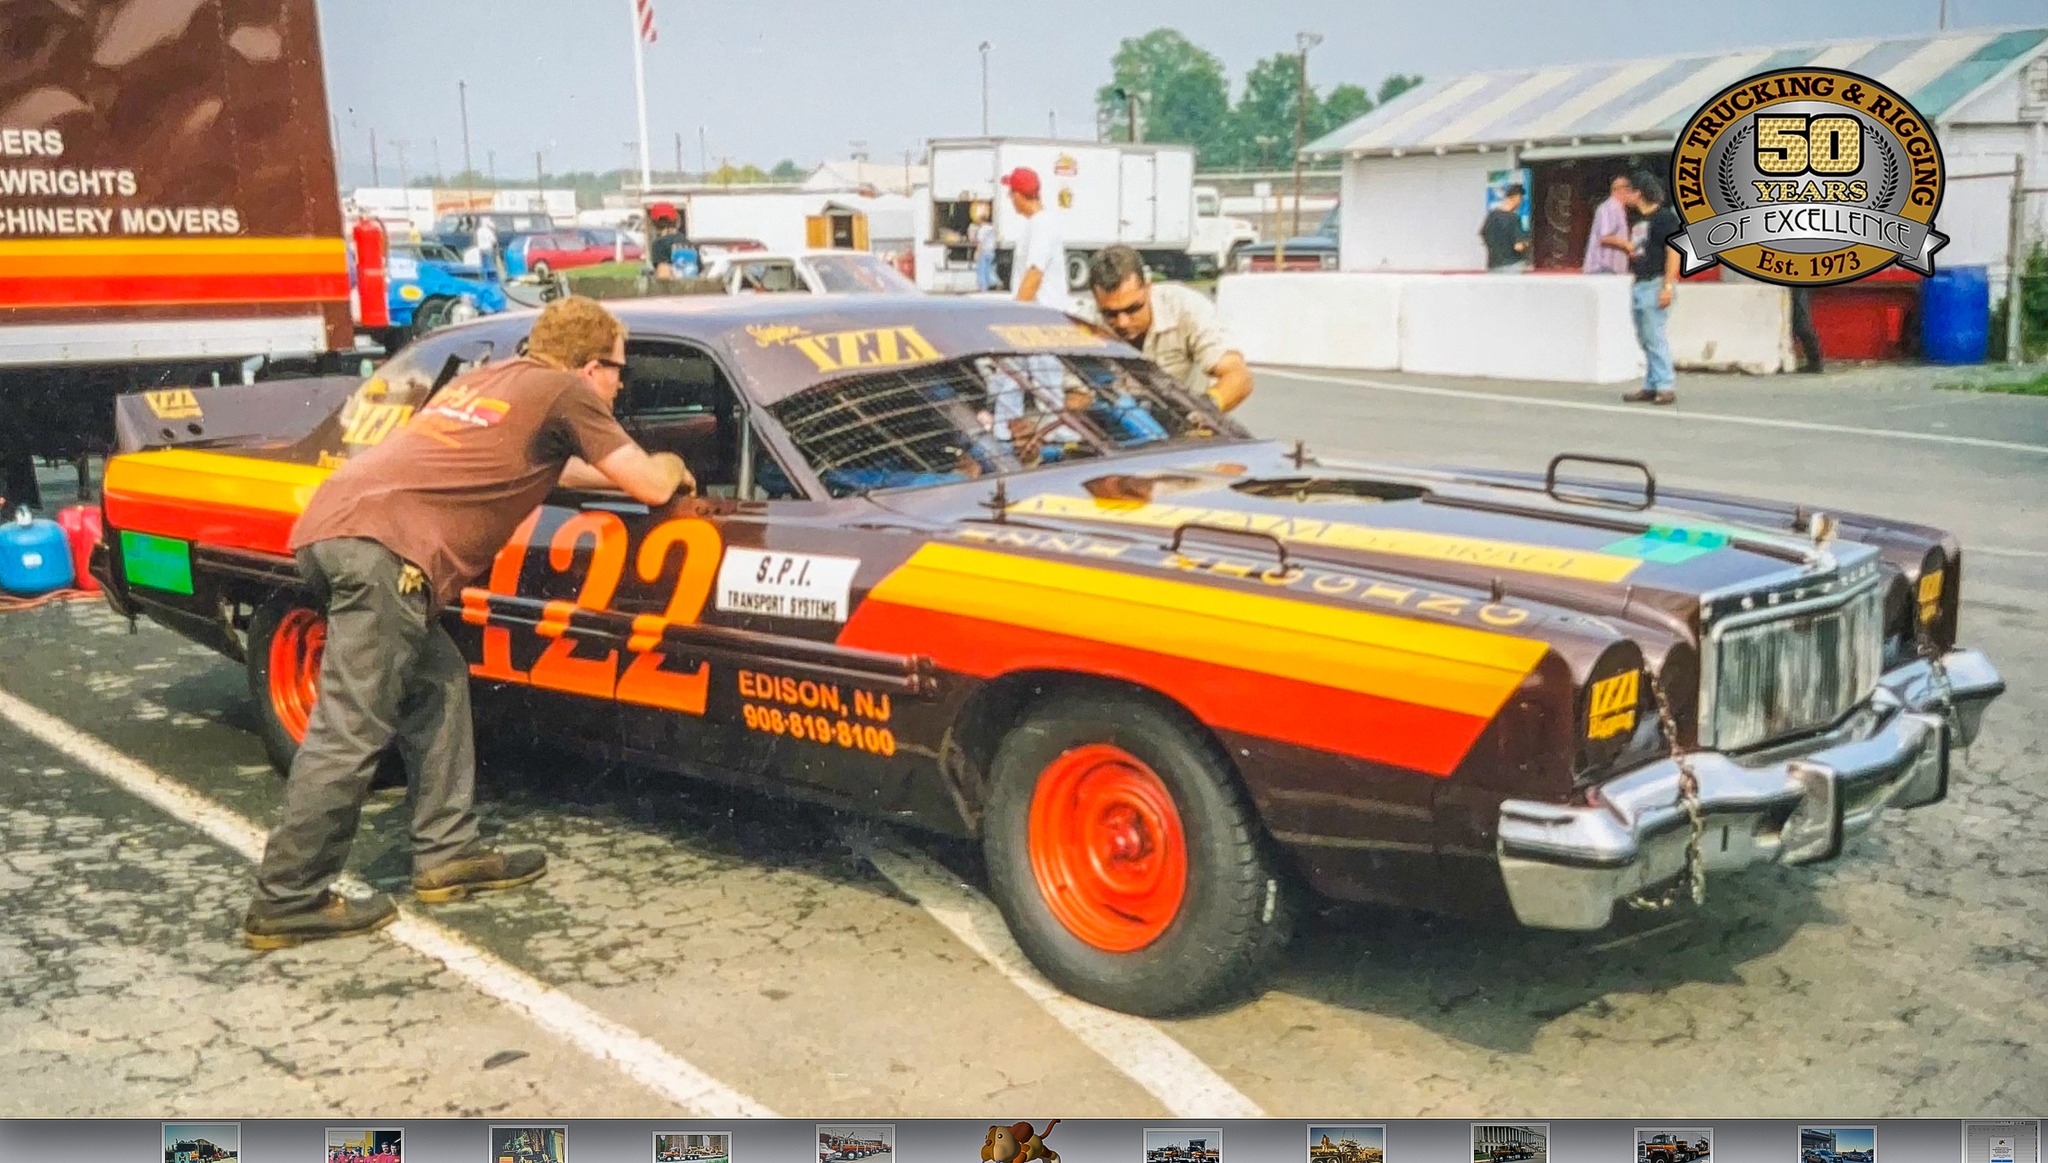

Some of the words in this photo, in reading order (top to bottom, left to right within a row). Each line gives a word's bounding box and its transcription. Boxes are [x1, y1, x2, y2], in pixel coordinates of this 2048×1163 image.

[0, 128, 65, 156] ERS
[0, 169, 138, 196] WRIGHTS
[121, 207, 241, 234] MOVERS
[756, 555, 812, 588] S.P.I.
[460, 504, 723, 716] 122
[728, 590, 785, 609] TRANSPORT
[790, 597, 837, 621] SYSTEMS
[738, 670, 848, 717] EDISON,
[853, 689, 892, 723] NJ
